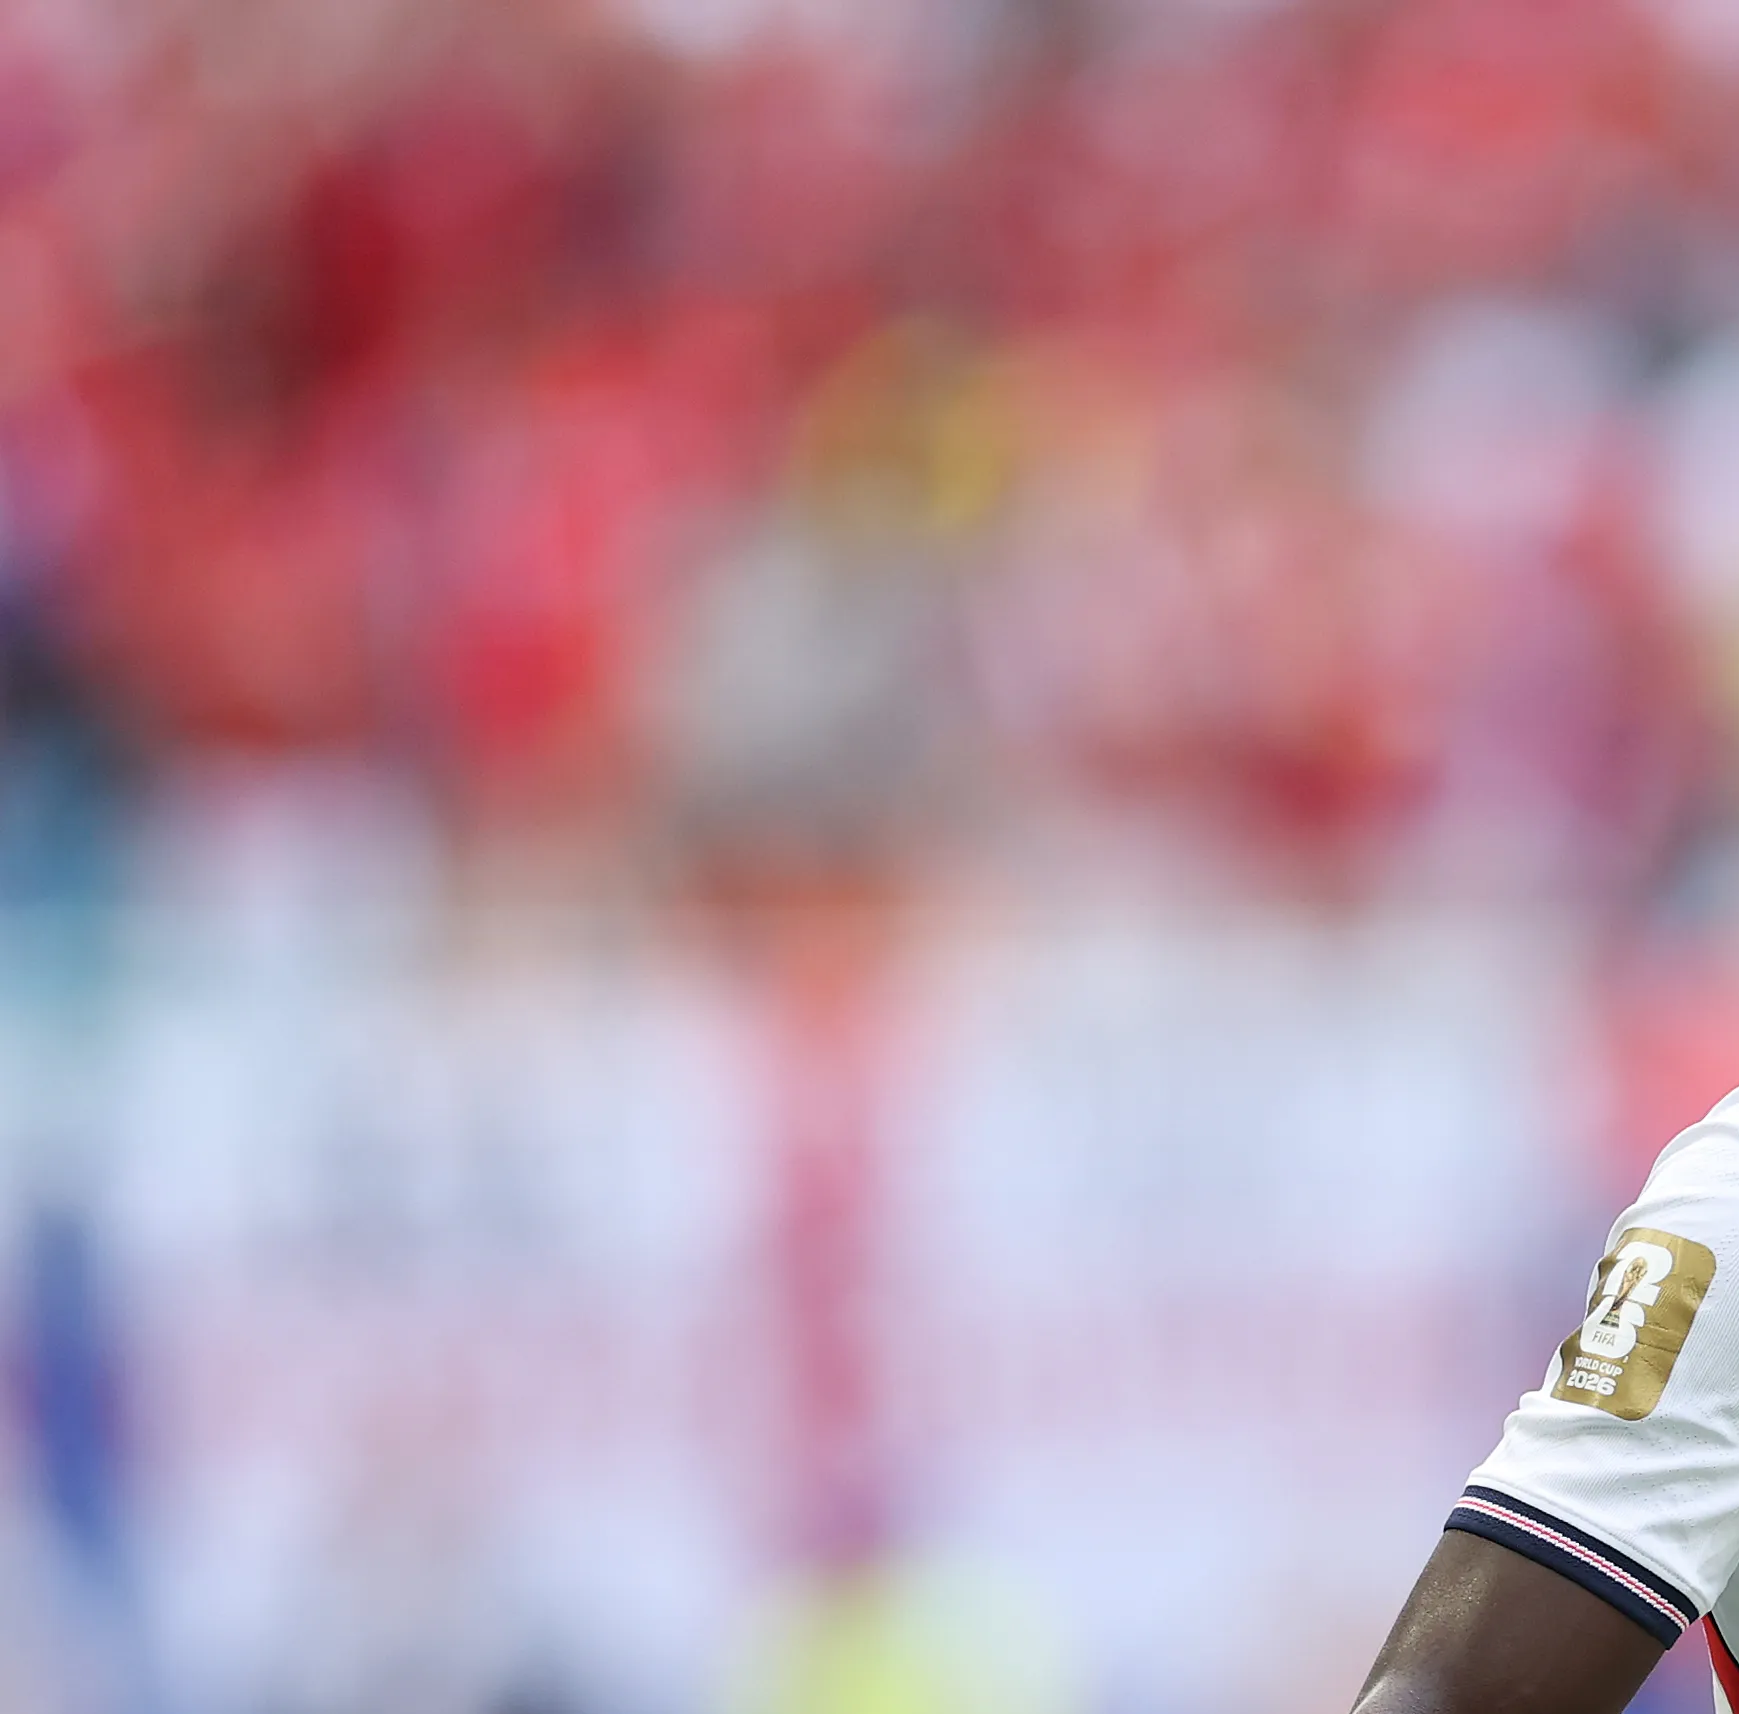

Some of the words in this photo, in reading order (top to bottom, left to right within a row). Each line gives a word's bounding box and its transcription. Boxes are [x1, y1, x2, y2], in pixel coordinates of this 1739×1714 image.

[1592, 1330, 1616, 1347] FIFA
[1599, 1362, 1623, 1377] CUP
[1566, 1369, 1617, 1396] 2026
